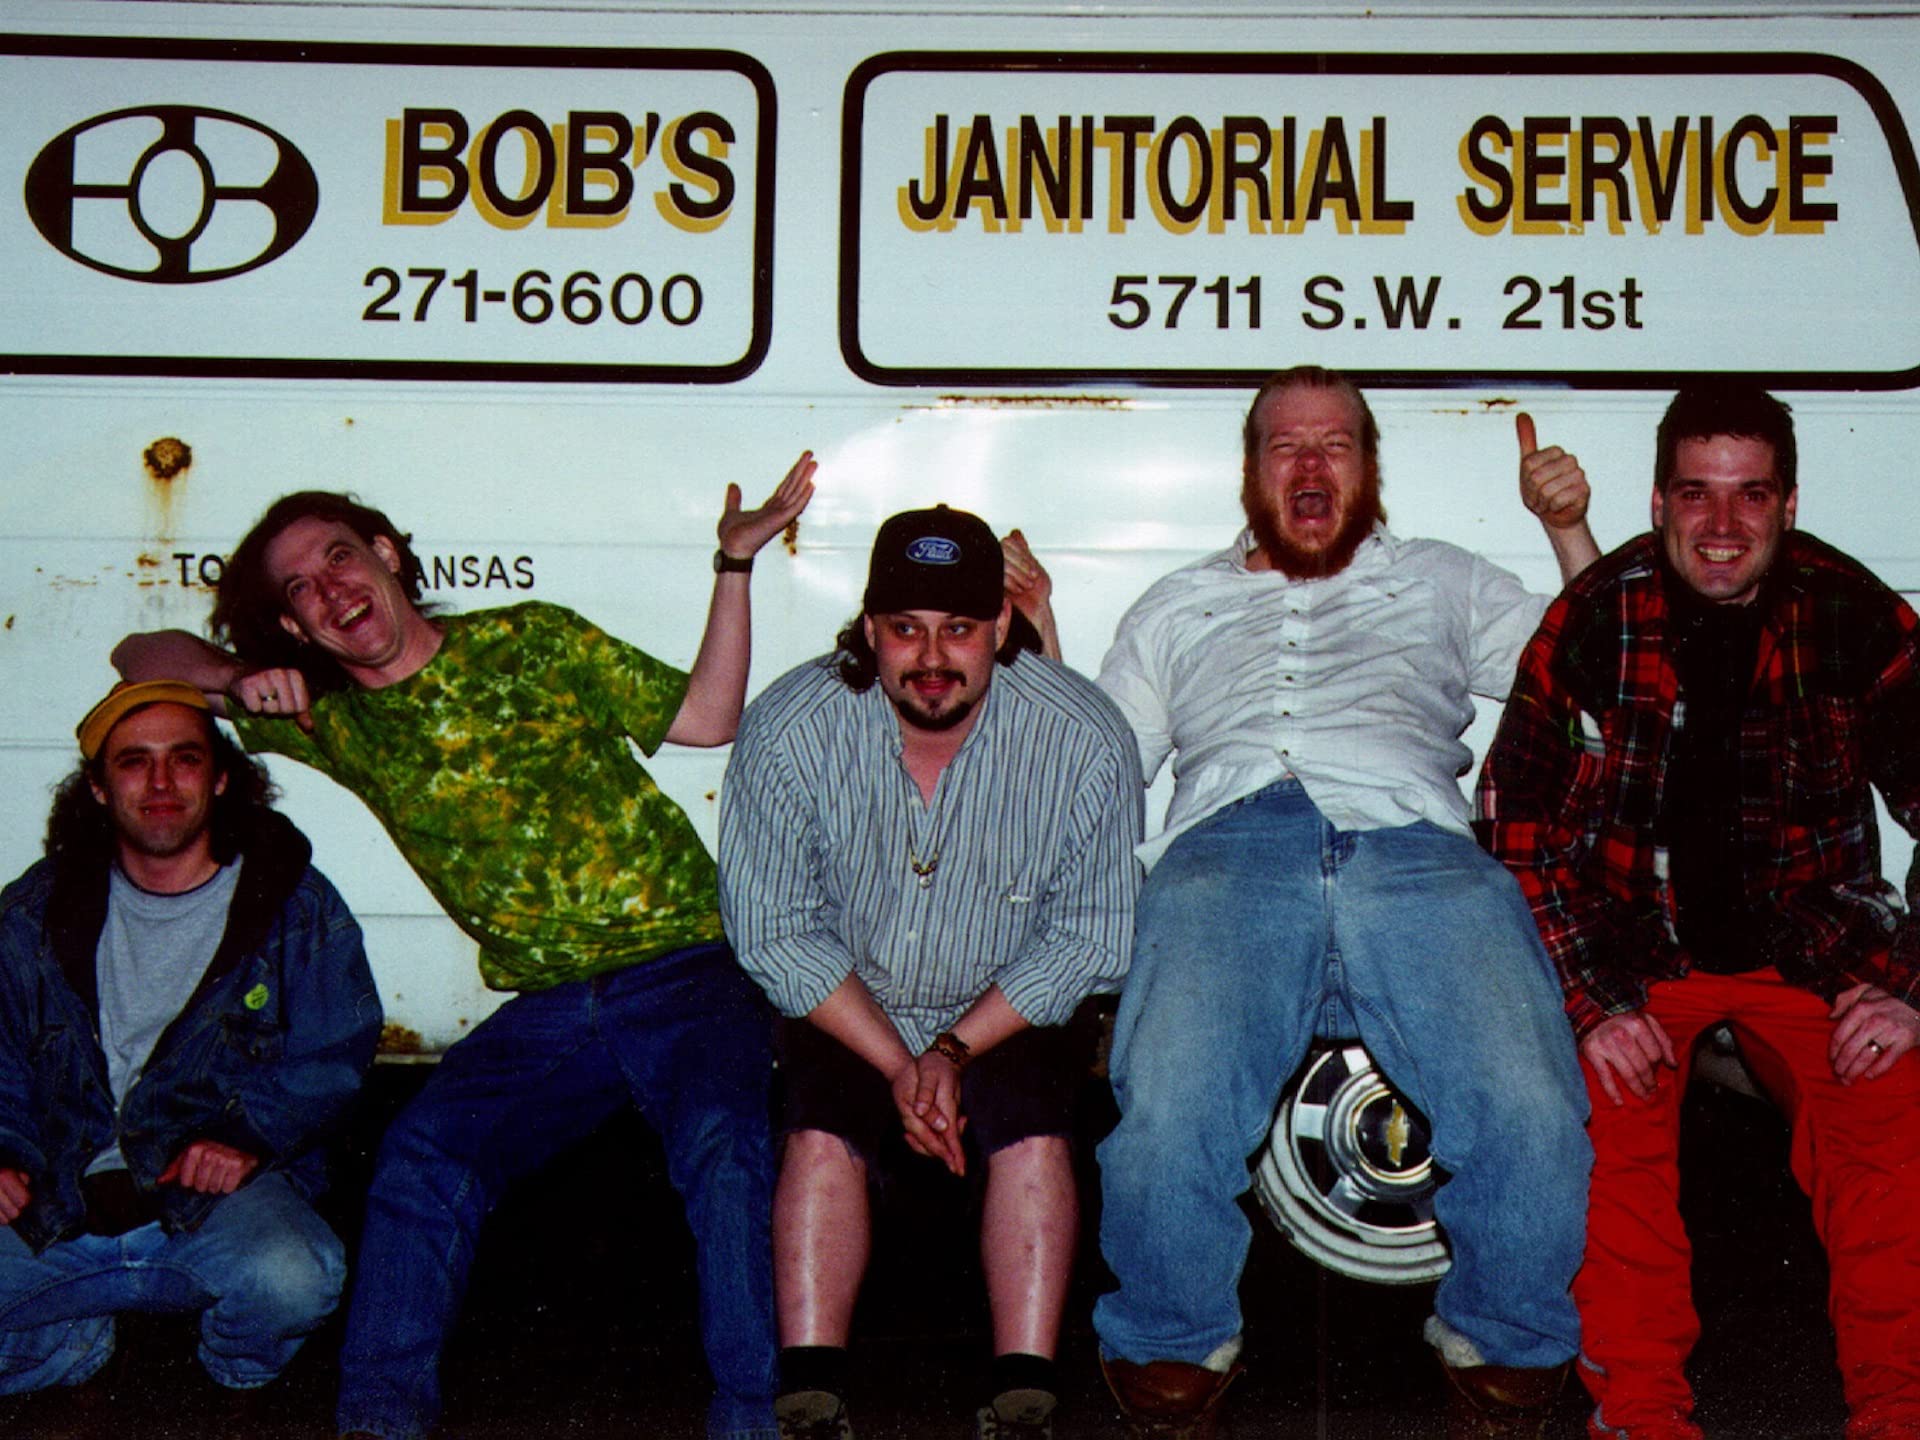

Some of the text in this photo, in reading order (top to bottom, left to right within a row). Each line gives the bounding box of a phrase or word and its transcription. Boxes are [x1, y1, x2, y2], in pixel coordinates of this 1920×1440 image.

[382, 108, 737, 234] BOB'S
[897, 114, 1839, 237] JANITORIAL SERVICE
[362, 267, 704, 327] 271-6600
[1107, 275, 1644, 331] 5711 S.W. 21st
[412, 554, 535, 590] ANSAS
[914, 541, 955, 561] Ford
